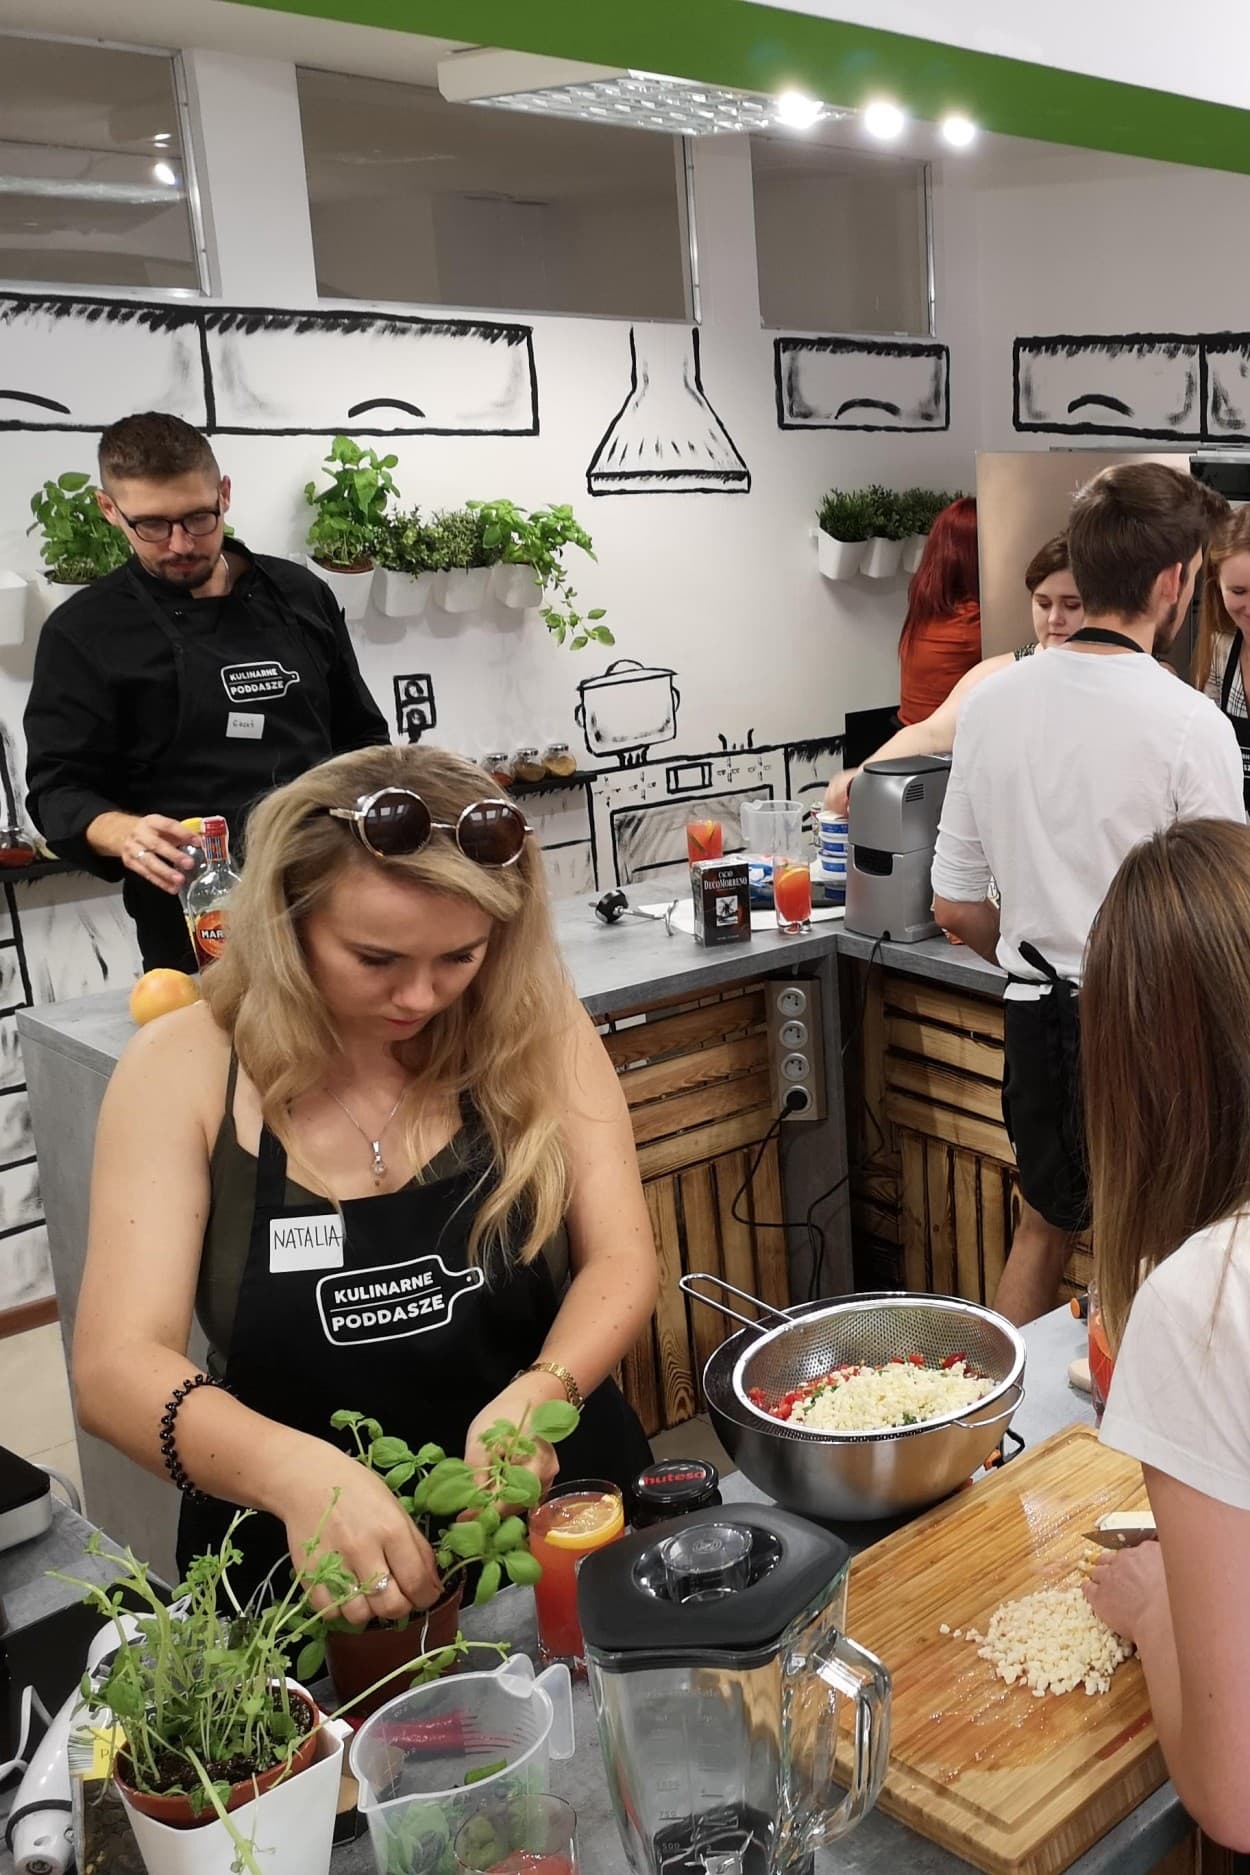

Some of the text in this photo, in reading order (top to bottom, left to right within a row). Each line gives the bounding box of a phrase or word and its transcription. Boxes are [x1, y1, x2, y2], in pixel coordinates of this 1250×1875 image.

[229, 668, 278, 681] KULINARNE
[230, 680, 284, 696] PODDASZE
[273, 1224, 344, 1251] NATALIA
[334, 1272, 433, 1304] KULINARNE
[332, 1294, 445, 1332] PODDASZE
